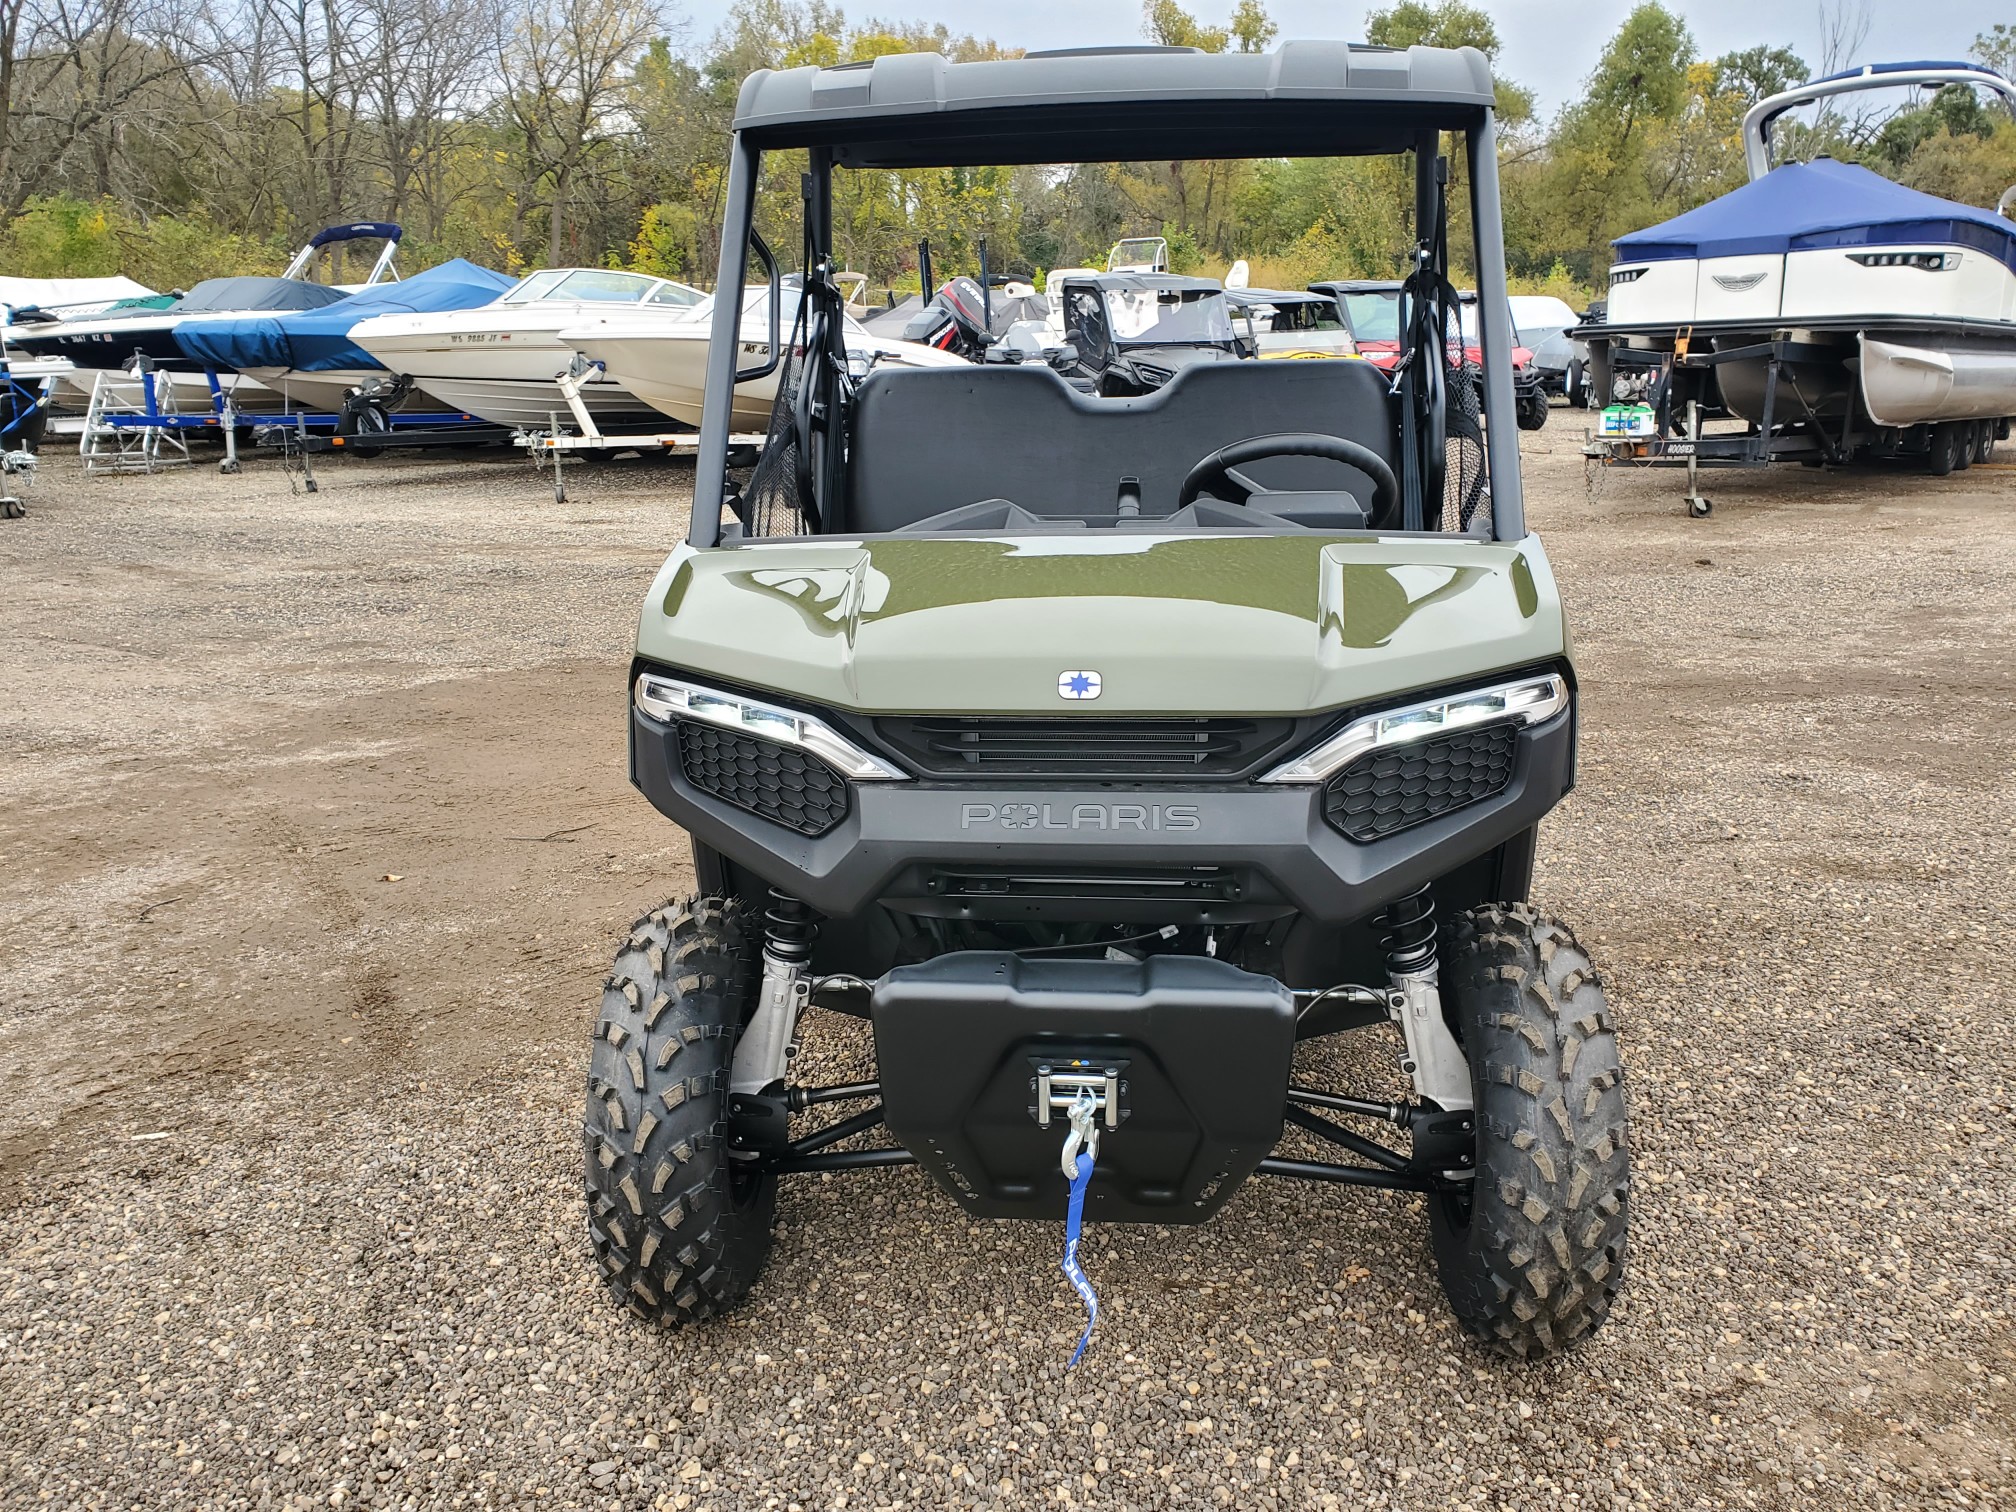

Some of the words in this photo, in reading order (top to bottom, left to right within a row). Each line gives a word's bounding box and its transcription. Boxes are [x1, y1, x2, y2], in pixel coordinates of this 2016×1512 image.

[451, 335, 463, 343] WS
[1667, 444, 1696, 454] HOOSIER
[961, 803, 1201, 831] POLARIS
